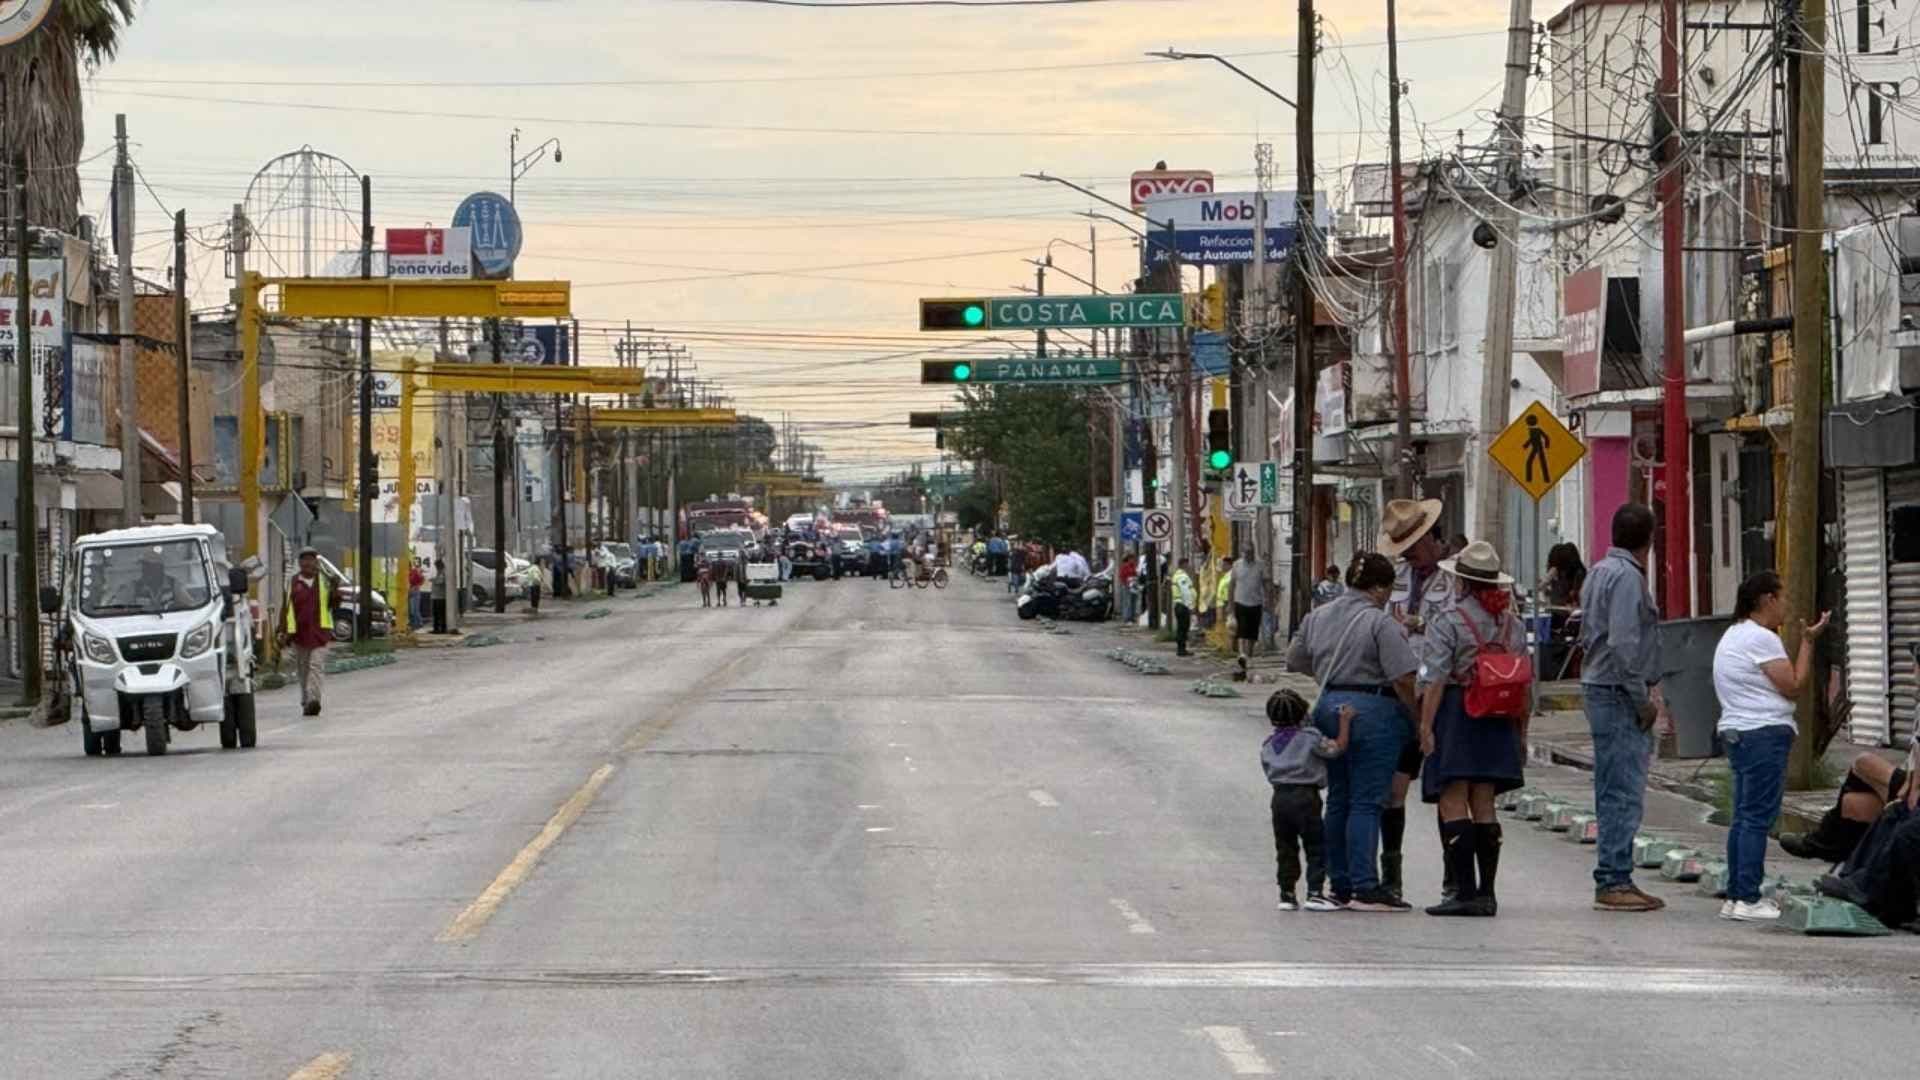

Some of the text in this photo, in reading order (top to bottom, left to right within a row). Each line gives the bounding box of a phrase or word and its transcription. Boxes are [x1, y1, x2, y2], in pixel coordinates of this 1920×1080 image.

[1134, 179, 1211, 203] OXXO
[1201, 201, 1268, 221] Mobl
[1199, 235, 1274, 247] Refacciona
[1153, 247, 1288, 261] Jinez Automot del
[387, 261, 468, 275] benavides
[0, 309, 54, 327] EIA
[1000, 301, 1177, 323] COSTA RICA
[998, 364, 1098, 378] PANAMA
[383, 483, 431, 494] JUCA
